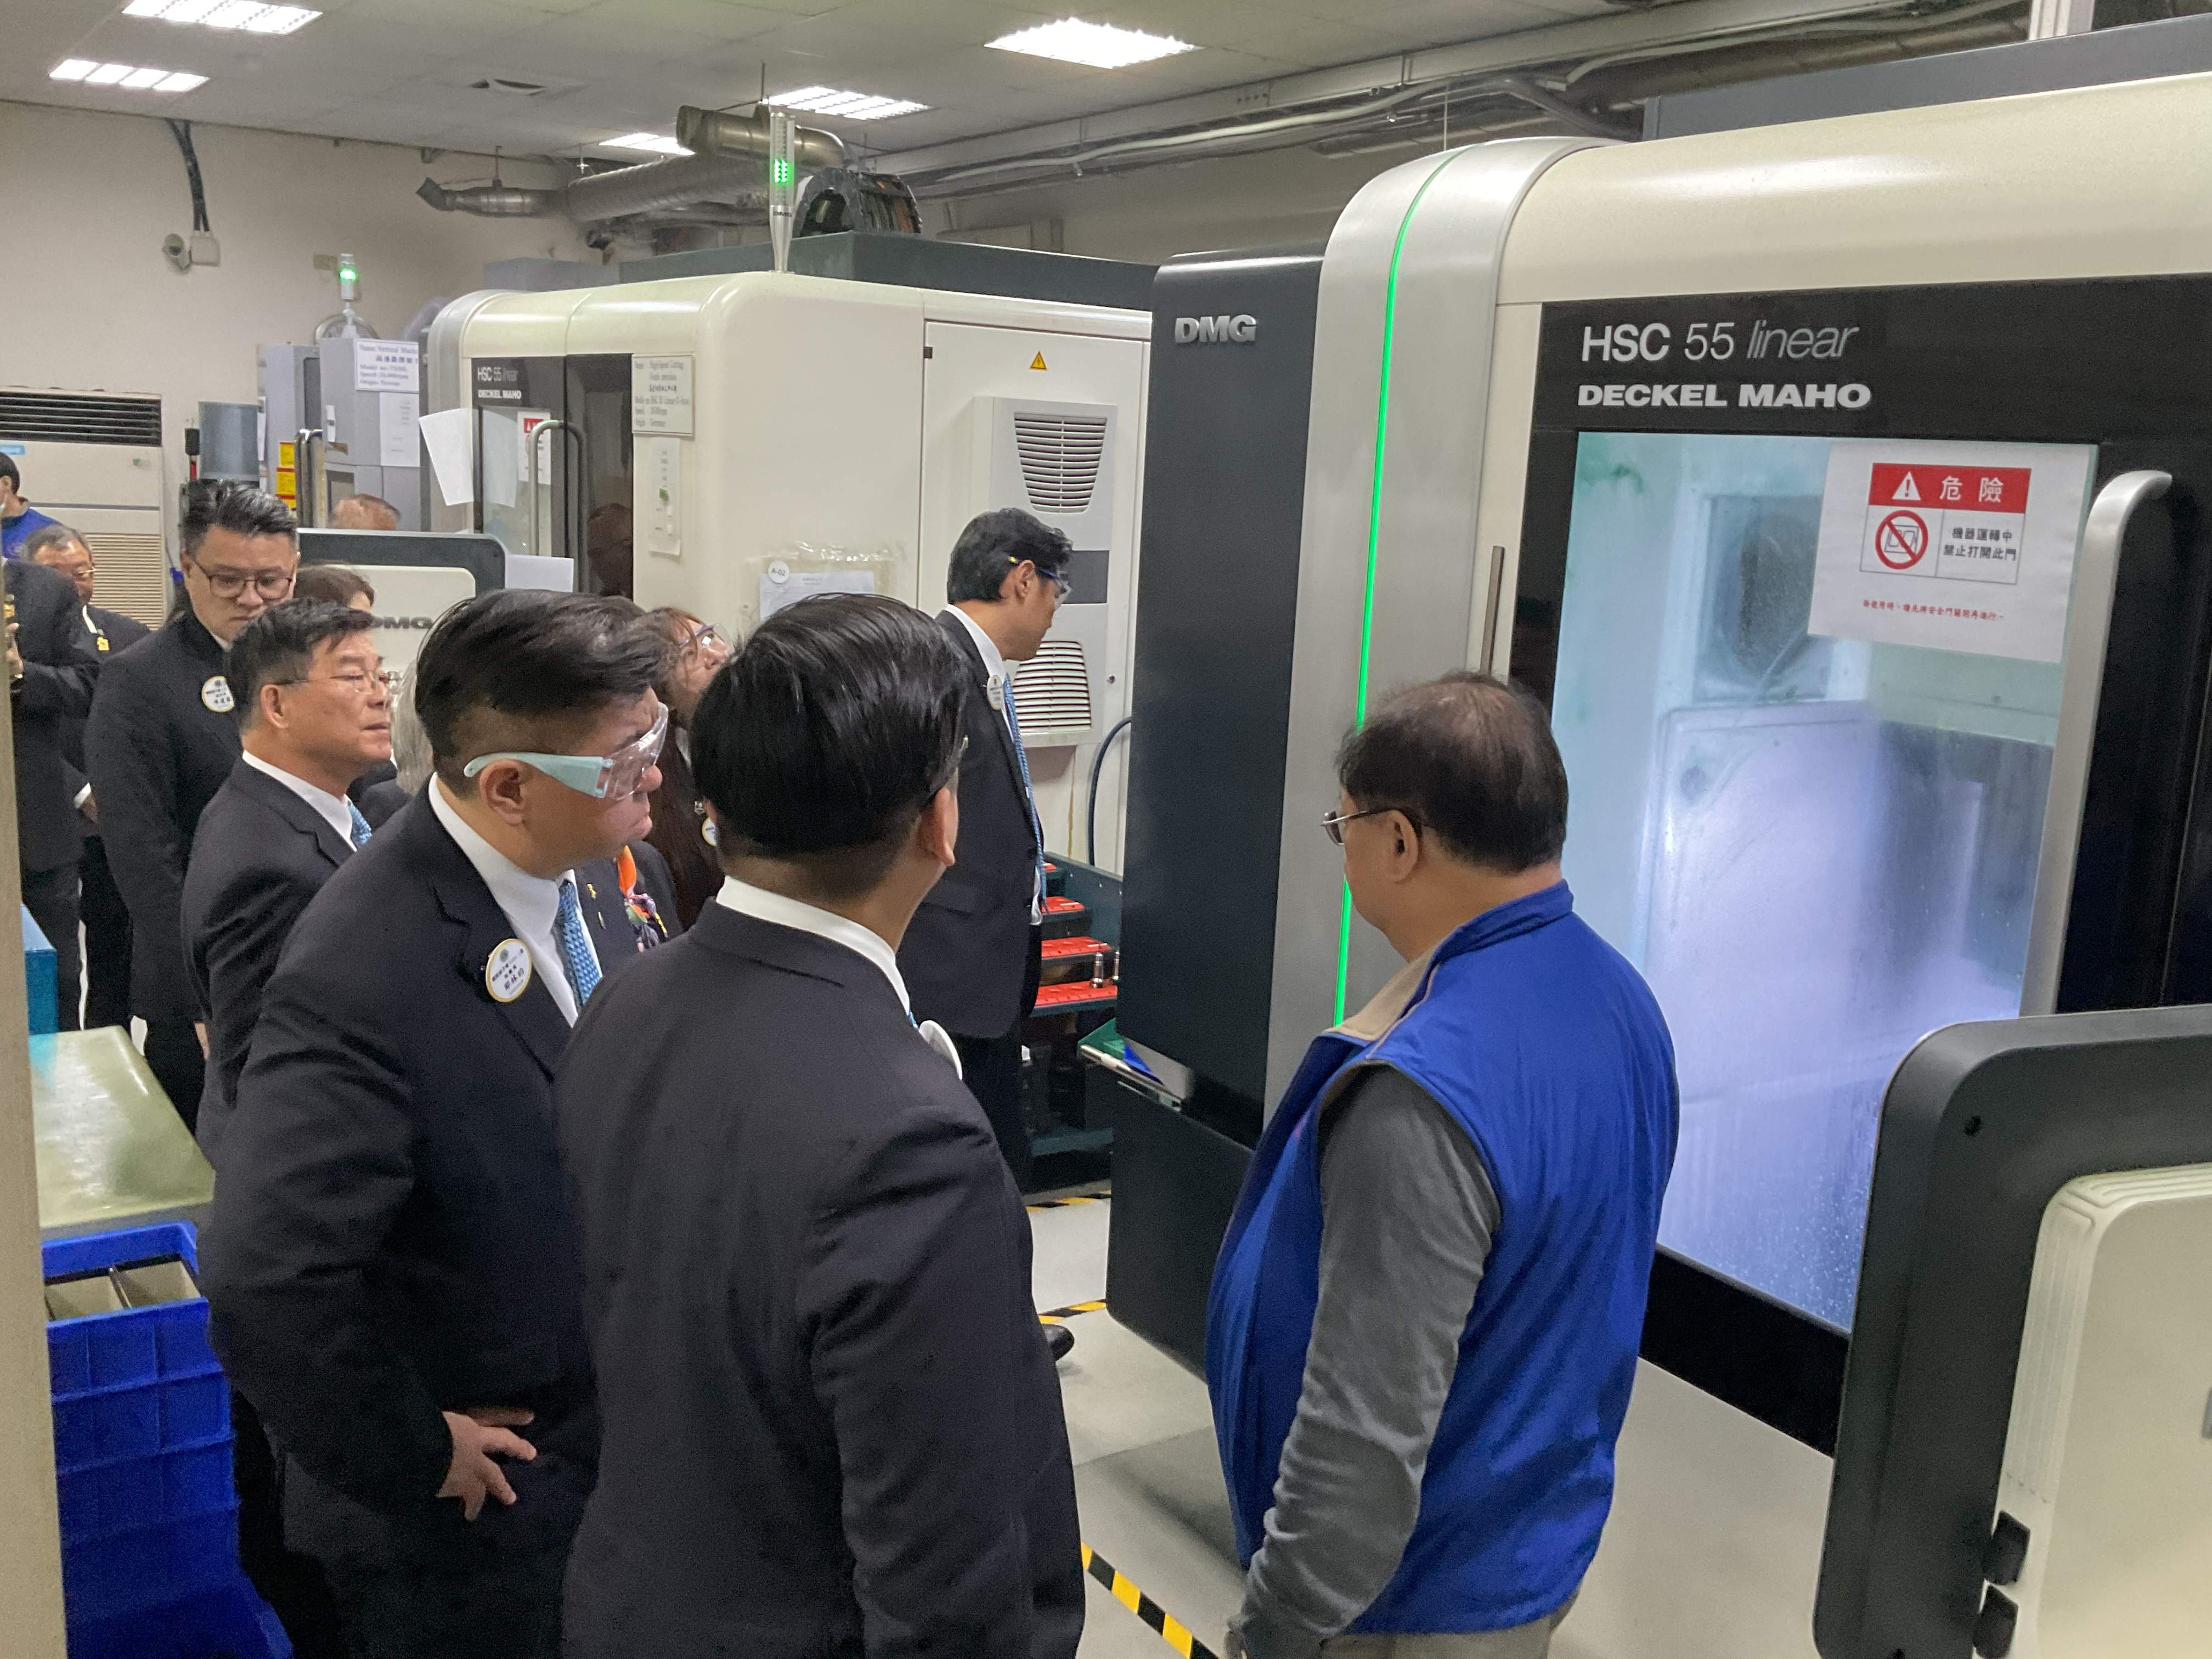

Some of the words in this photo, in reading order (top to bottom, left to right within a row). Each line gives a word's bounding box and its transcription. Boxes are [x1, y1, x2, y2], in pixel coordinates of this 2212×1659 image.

[1174, 314, 1256, 343] DMG
[1582, 324, 1671, 362] HSC
[1684, 322, 1734, 360] 55
[1747, 319, 1859, 358] linear
[477, 366, 492, 381] HSC
[494, 367, 501, 381] 55
[1578, 384, 1728, 407] DECKEL
[1739, 383, 1871, 408] MAHO
[1939, 475, 2004, 503] 危險
[1951, 527, 2012, 543] 機器運轉中
[1943, 545, 2017, 561] 禁止打開此門
[771, 567, 786, 576] A-02
